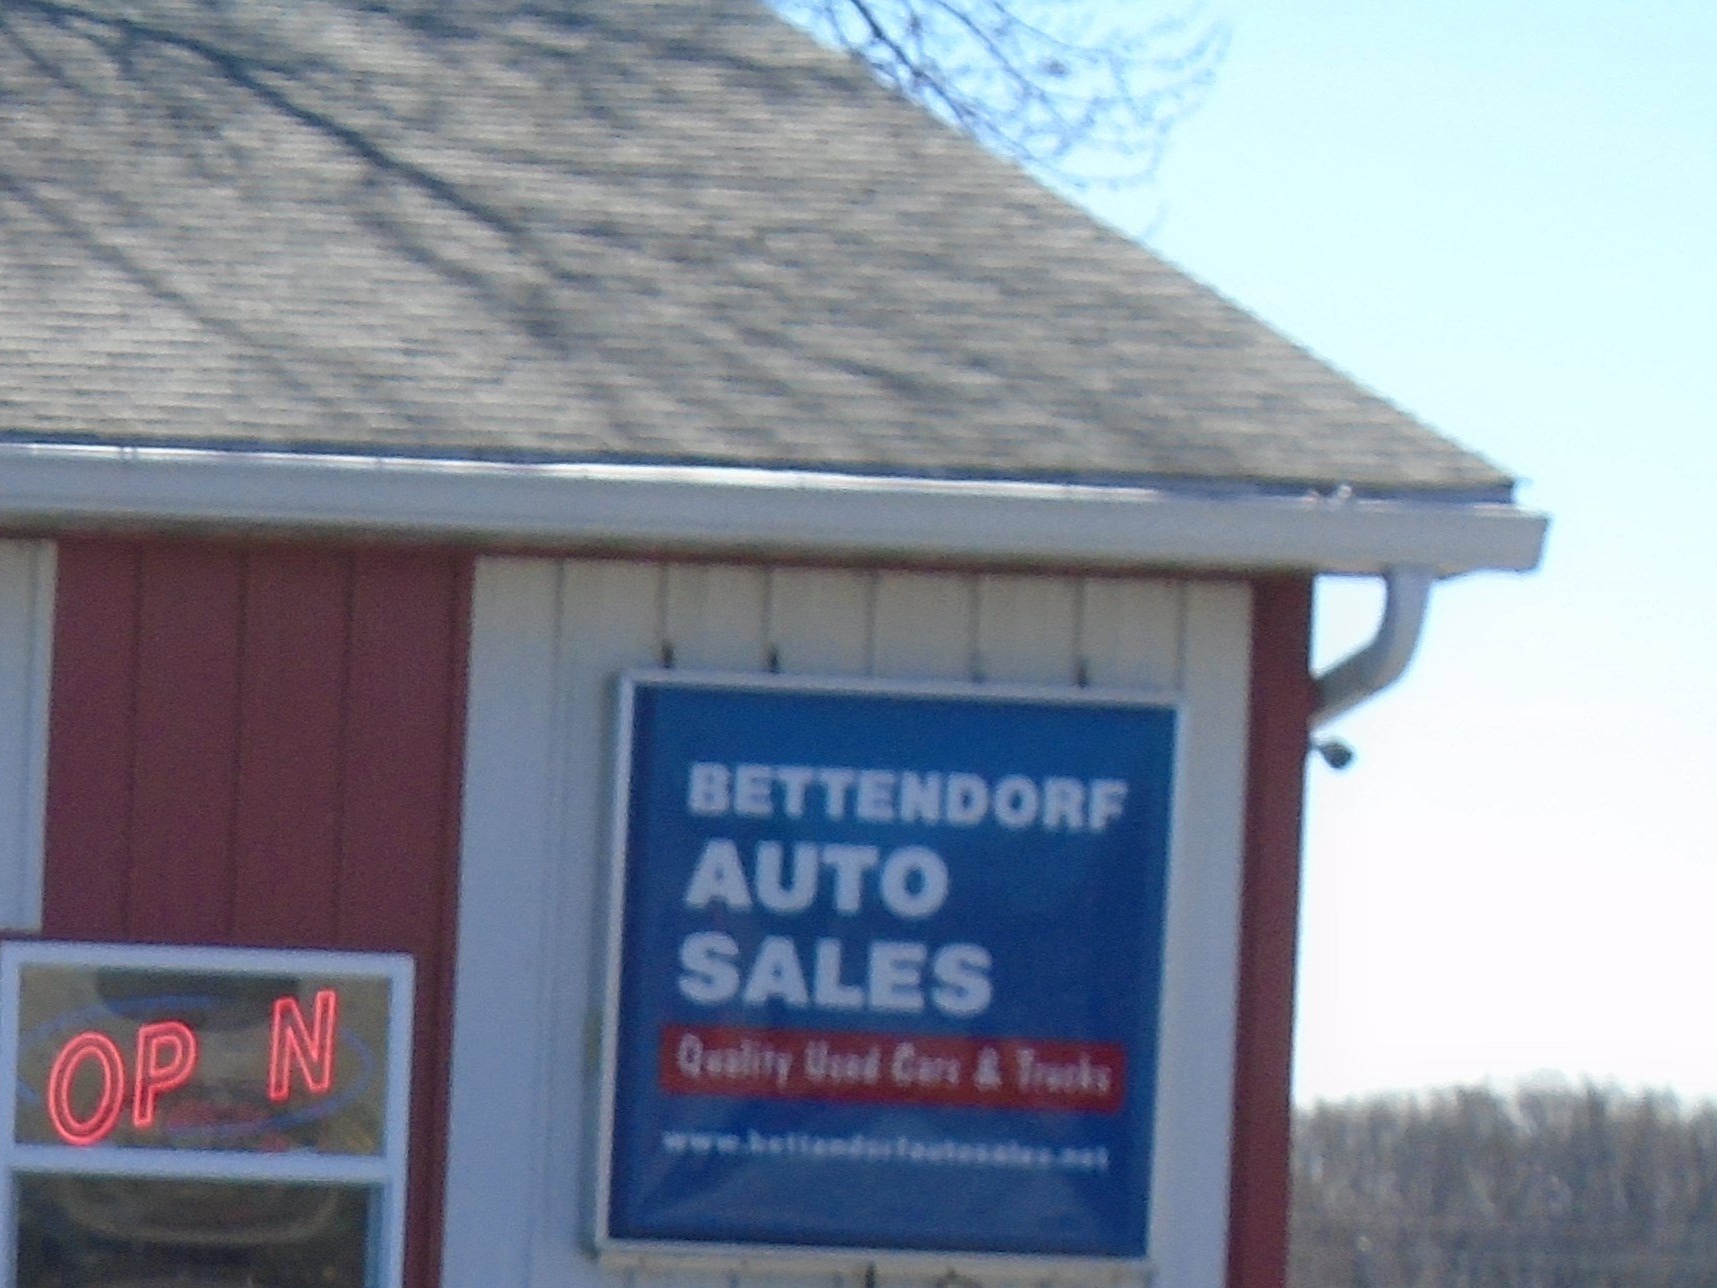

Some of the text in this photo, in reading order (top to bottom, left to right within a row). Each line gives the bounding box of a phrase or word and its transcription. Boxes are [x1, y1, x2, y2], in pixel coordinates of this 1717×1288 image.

[687, 760, 1128, 831] BETTENDORF
[684, 838, 950, 918] AUTO
[678, 930, 994, 1017] SALES
[677, 1033, 1112, 1094] Quality Used Cars & Trucks
